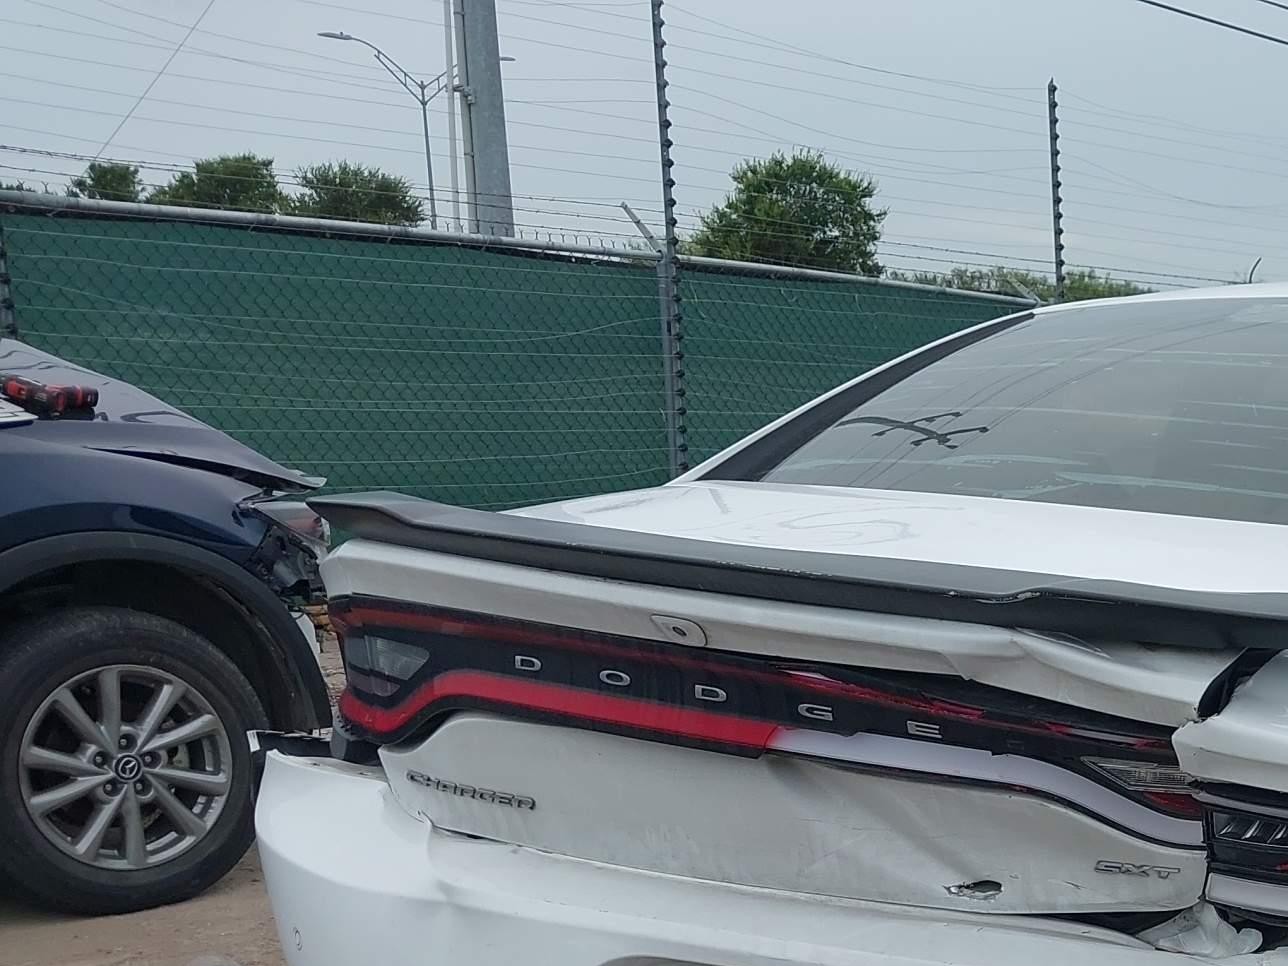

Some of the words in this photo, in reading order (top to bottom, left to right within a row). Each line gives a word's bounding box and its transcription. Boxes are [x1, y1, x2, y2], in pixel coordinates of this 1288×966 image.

[514, 655, 943, 739] DODGE
[406, 770, 536, 810] CHARGER
[1095, 860, 1181, 879] SXT
